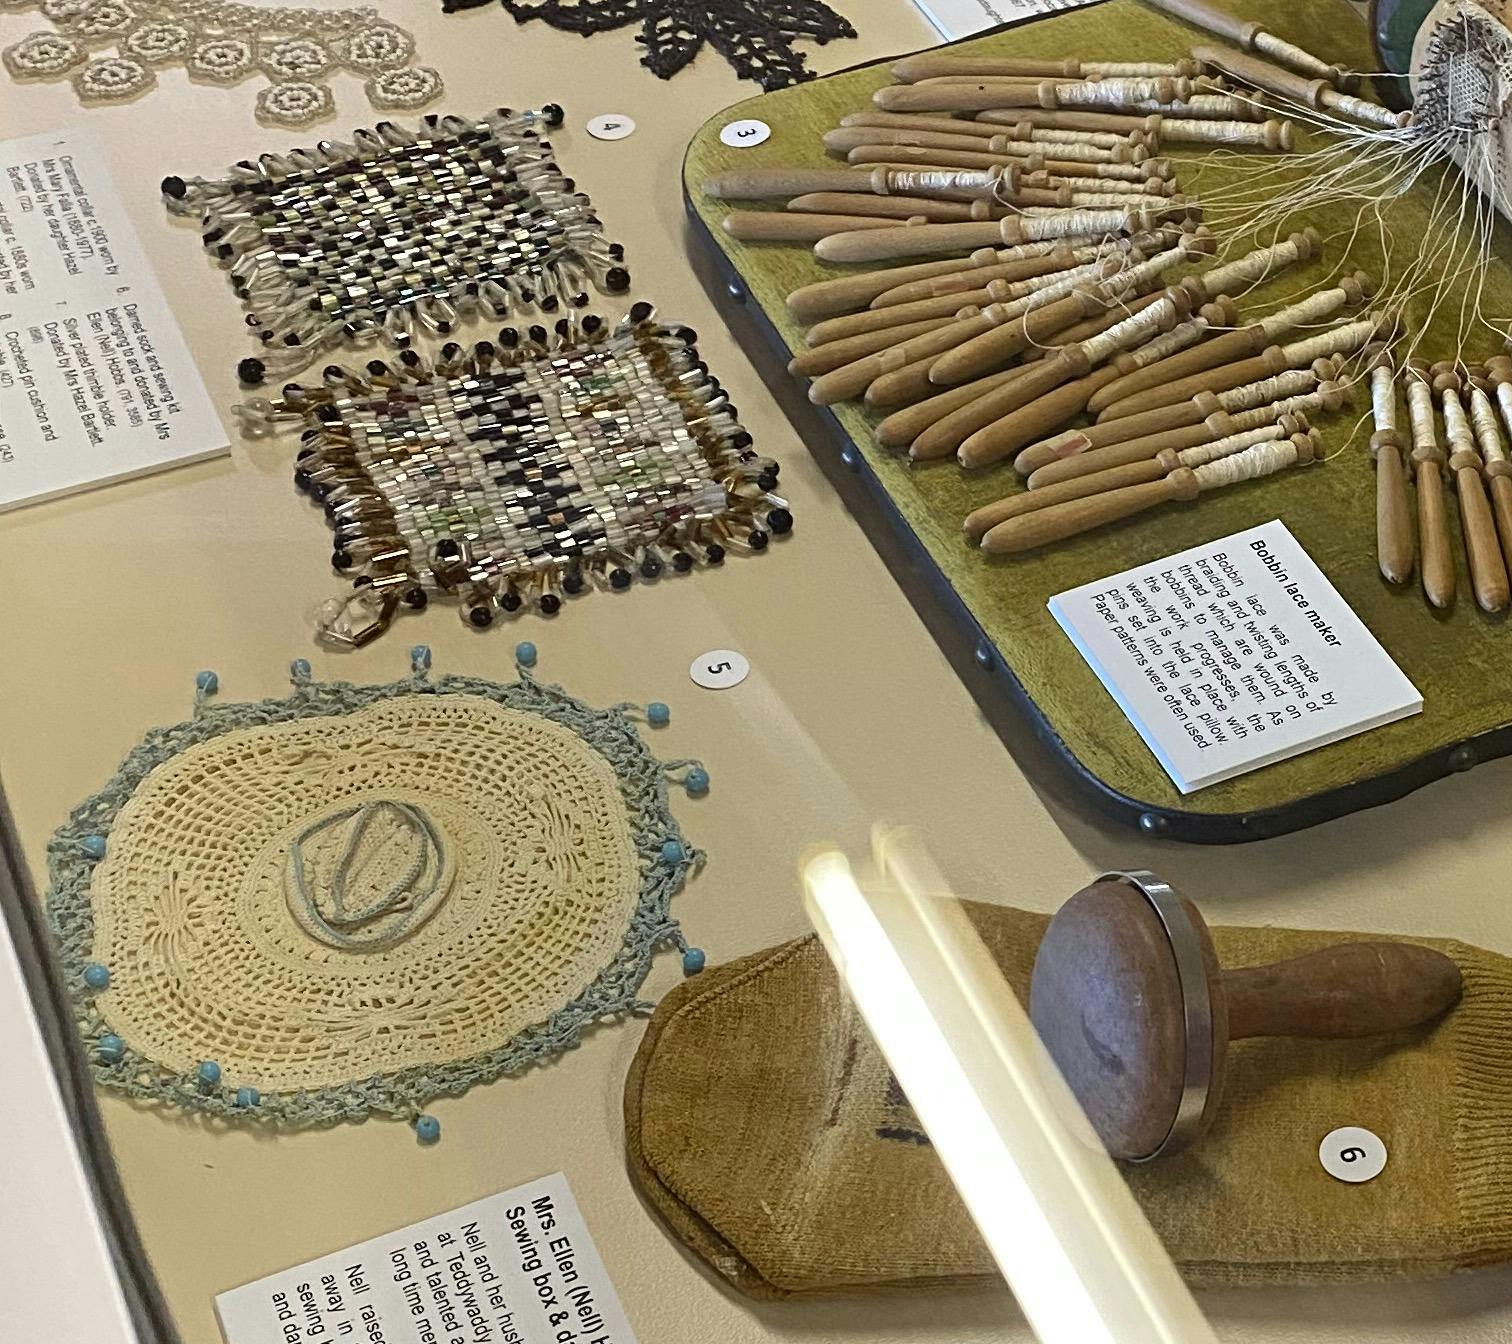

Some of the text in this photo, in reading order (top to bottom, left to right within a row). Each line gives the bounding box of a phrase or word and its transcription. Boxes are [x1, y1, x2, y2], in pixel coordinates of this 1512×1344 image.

[737, 128, 755, 138] 3
[1249, 539, 1342, 647] Bobbin lace maker
[1090, 593, 1119, 624] Paper
[1109, 625, 1149, 667] patterns
[1144, 666, 1168, 693] were
[1163, 694, 1189, 721] often
[1104, 588, 1130, 610] pins
[1127, 615, 1149, 632] set
[1143, 636, 1164, 656] into
[1161, 660, 1181, 679] the
[1178, 683, 1201, 707] lace
[1125, 581, 1249, 739] weaving is held in place with
[1143, 575, 1162, 594] the
[1165, 604, 1190, 631] work
[1246, 713, 1266, 733] the
[1160, 569, 1196, 610] bobbins
[1193, 613, 1208, 625] to
[1205, 629, 1242, 671] manage
[1265, 711, 1284, 726] As
[1177, 564, 1302, 720] thread which are wound on
[1194, 558, 1324, 713] braiding and twisting lengths of
[1212, 552, 1338, 706] Bobbin lace was made by
[707, 662, 731, 674] 5
[413, 1240, 440, 1269] and
[437, 1232, 457, 1249] at
[460, 1221, 488, 1253] Nell
[473, 1255, 500, 1284] and
[505, 1206, 543, 1273] Sewing
[532, 1271, 559, 1310] box
[548, 1310, 570, 1328] &
[530, 1195, 556, 1236] Mrs.
[548, 1236, 579, 1284] Ellen
[564, 1285, 605, 1335] (Nell)
[271, 1292, 297, 1321] and
[296, 1282, 326, 1337] sewing
[320, 1274, 346, 1313] away
[336, 1320, 353, 1336] in
[344, 1263, 371, 1295] Nell
[389, 1247, 412, 1282] long
[402, 1282, 425, 1316] time
[425, 1271, 464, 1333] talented
[446, 1250, 494, 1344] Teddywaddy
[484, 1283, 507, 1310] her
